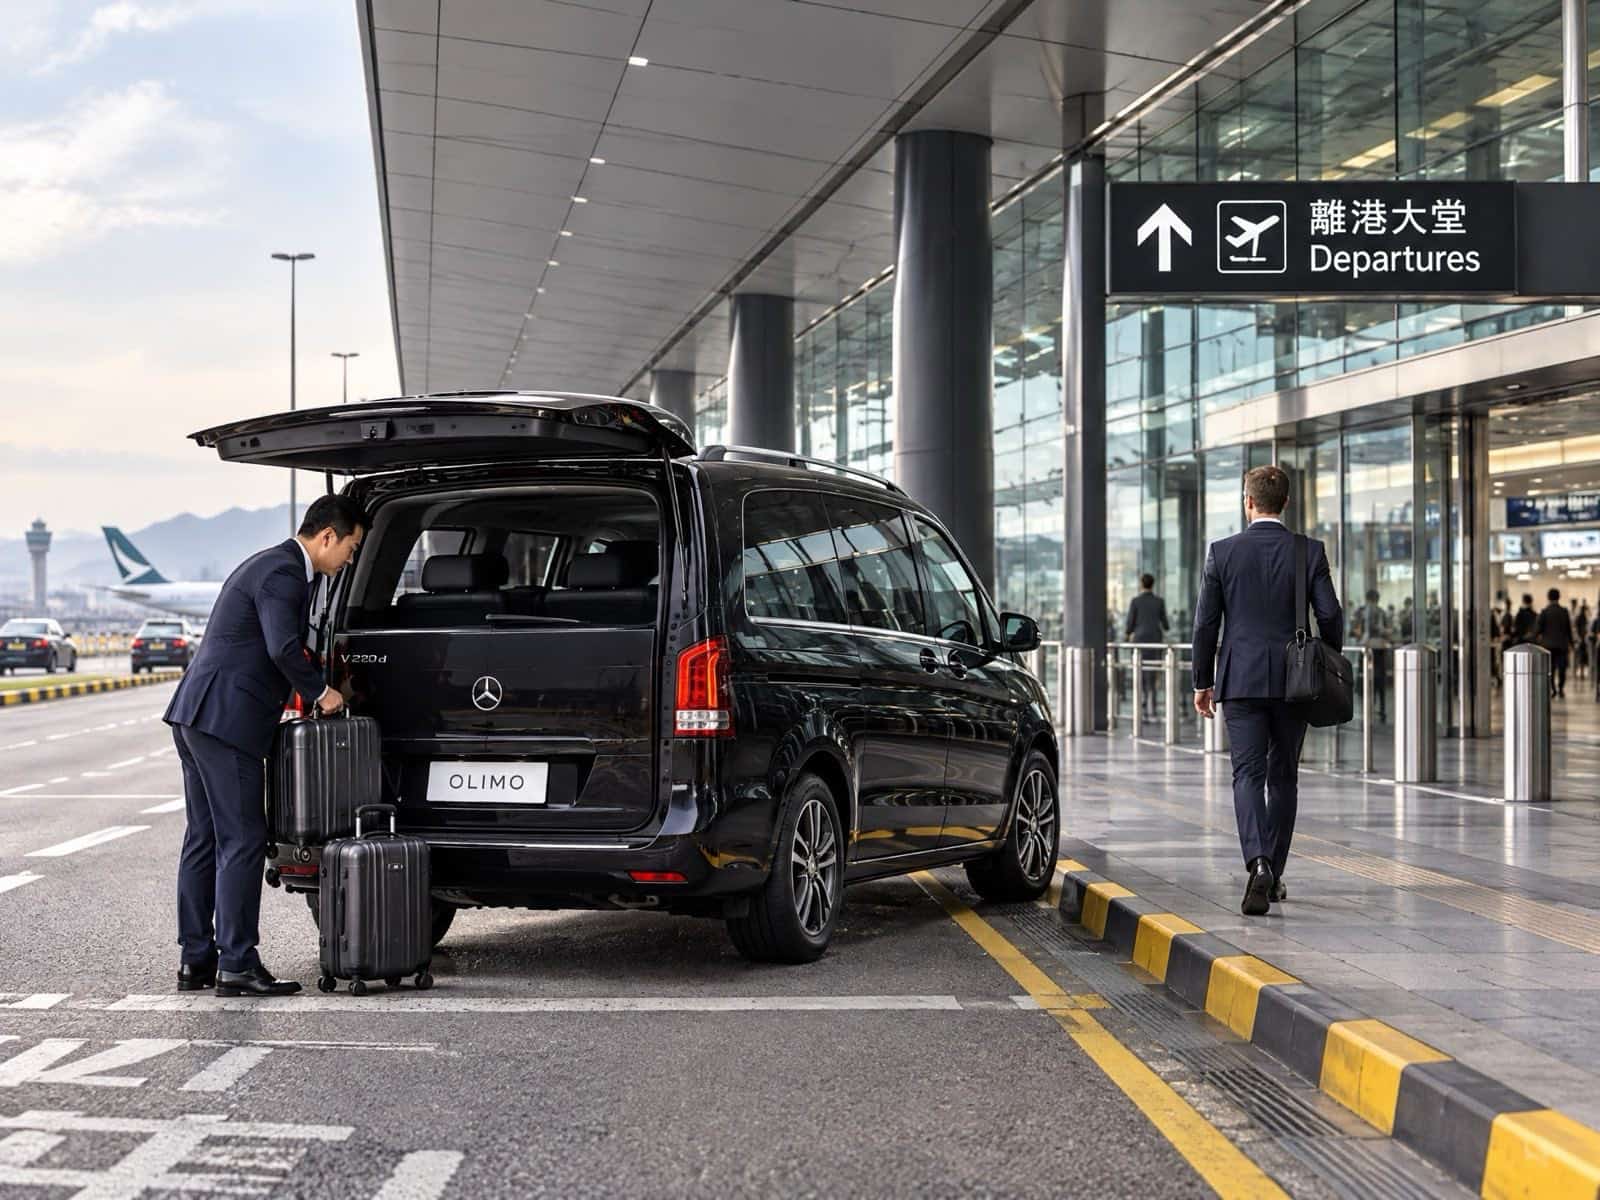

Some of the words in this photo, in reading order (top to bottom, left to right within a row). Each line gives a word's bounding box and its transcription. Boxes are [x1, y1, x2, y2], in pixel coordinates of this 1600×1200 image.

[1309, 198, 1467, 235] 離港大堂
[1309, 244, 1481, 279] Departures
[449, 774, 524, 790] OLIMO
